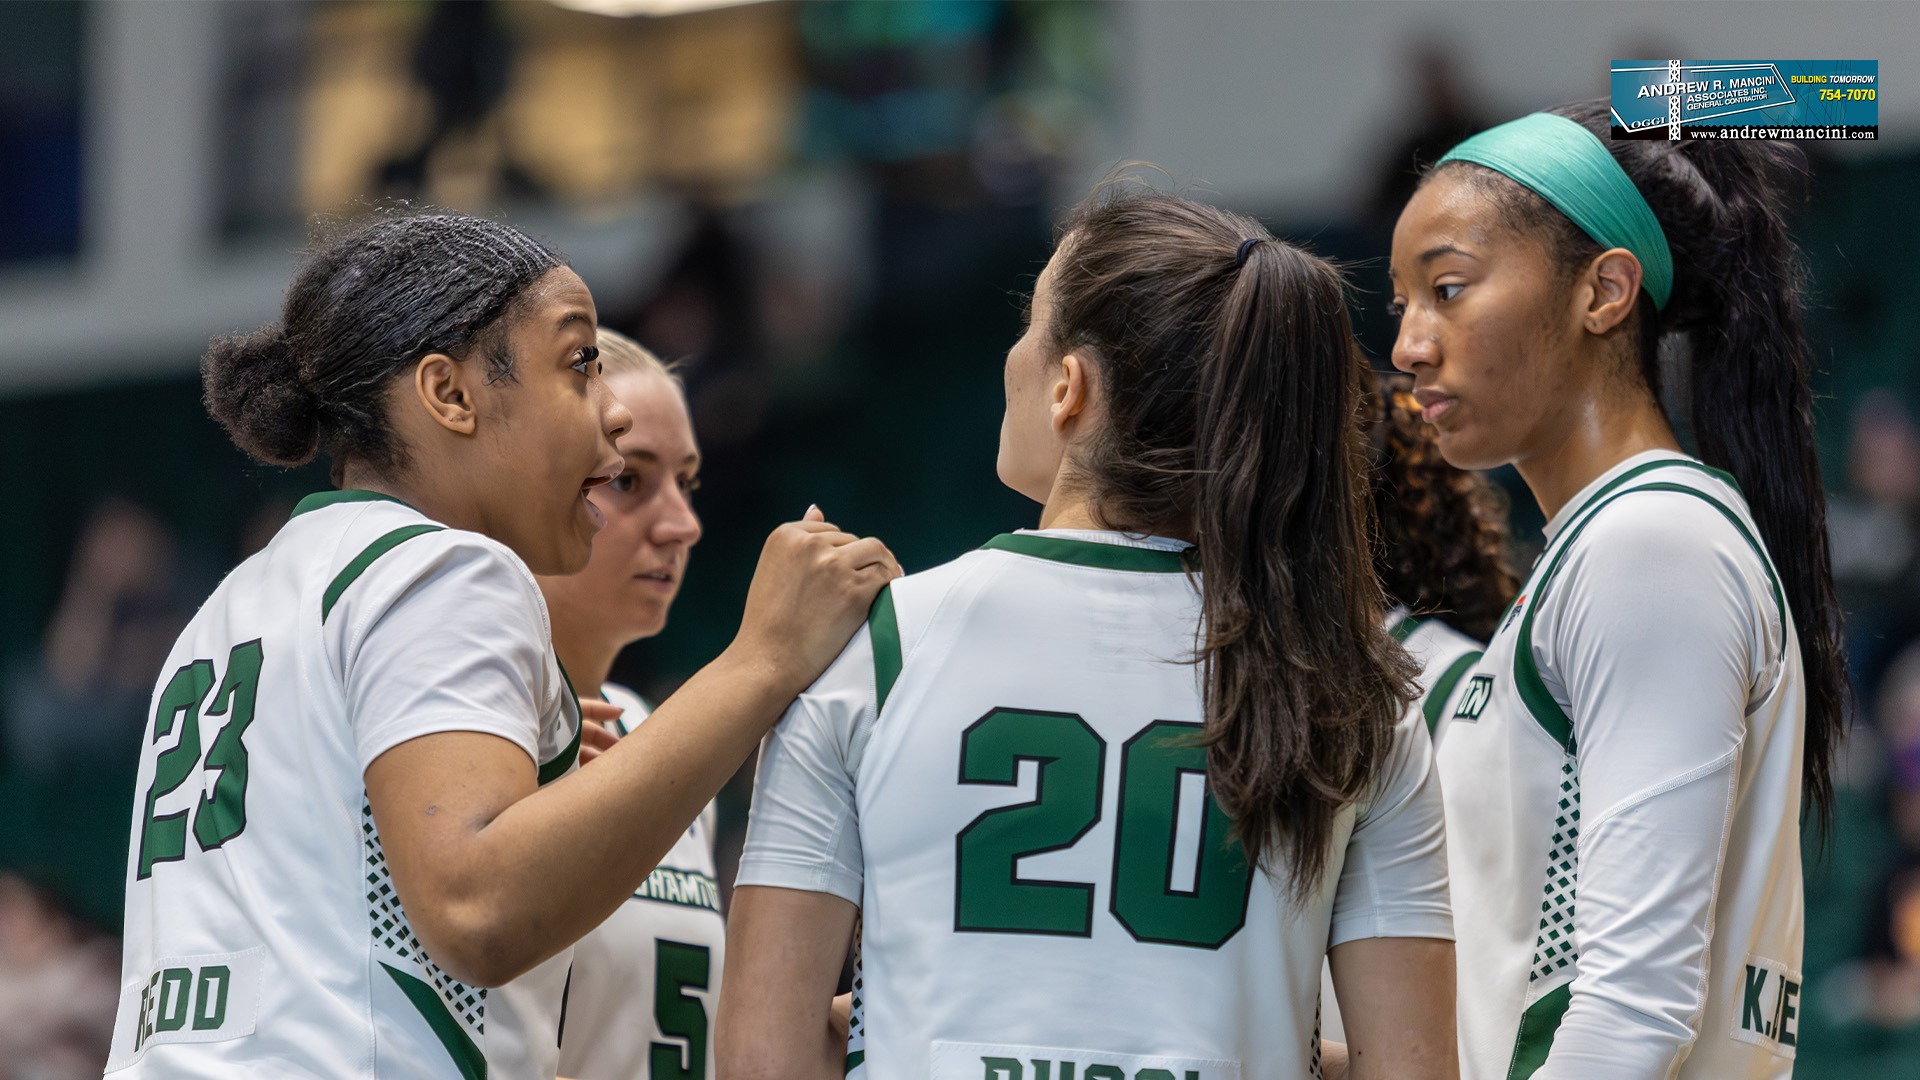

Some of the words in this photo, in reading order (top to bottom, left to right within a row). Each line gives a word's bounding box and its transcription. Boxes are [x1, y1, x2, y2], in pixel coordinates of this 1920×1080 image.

[136, 637, 264, 881] 23
[953, 706, 1258, 951] 20
[134, 964, 231, 1053] REDD
[648, 937, 710, 1080] 5
